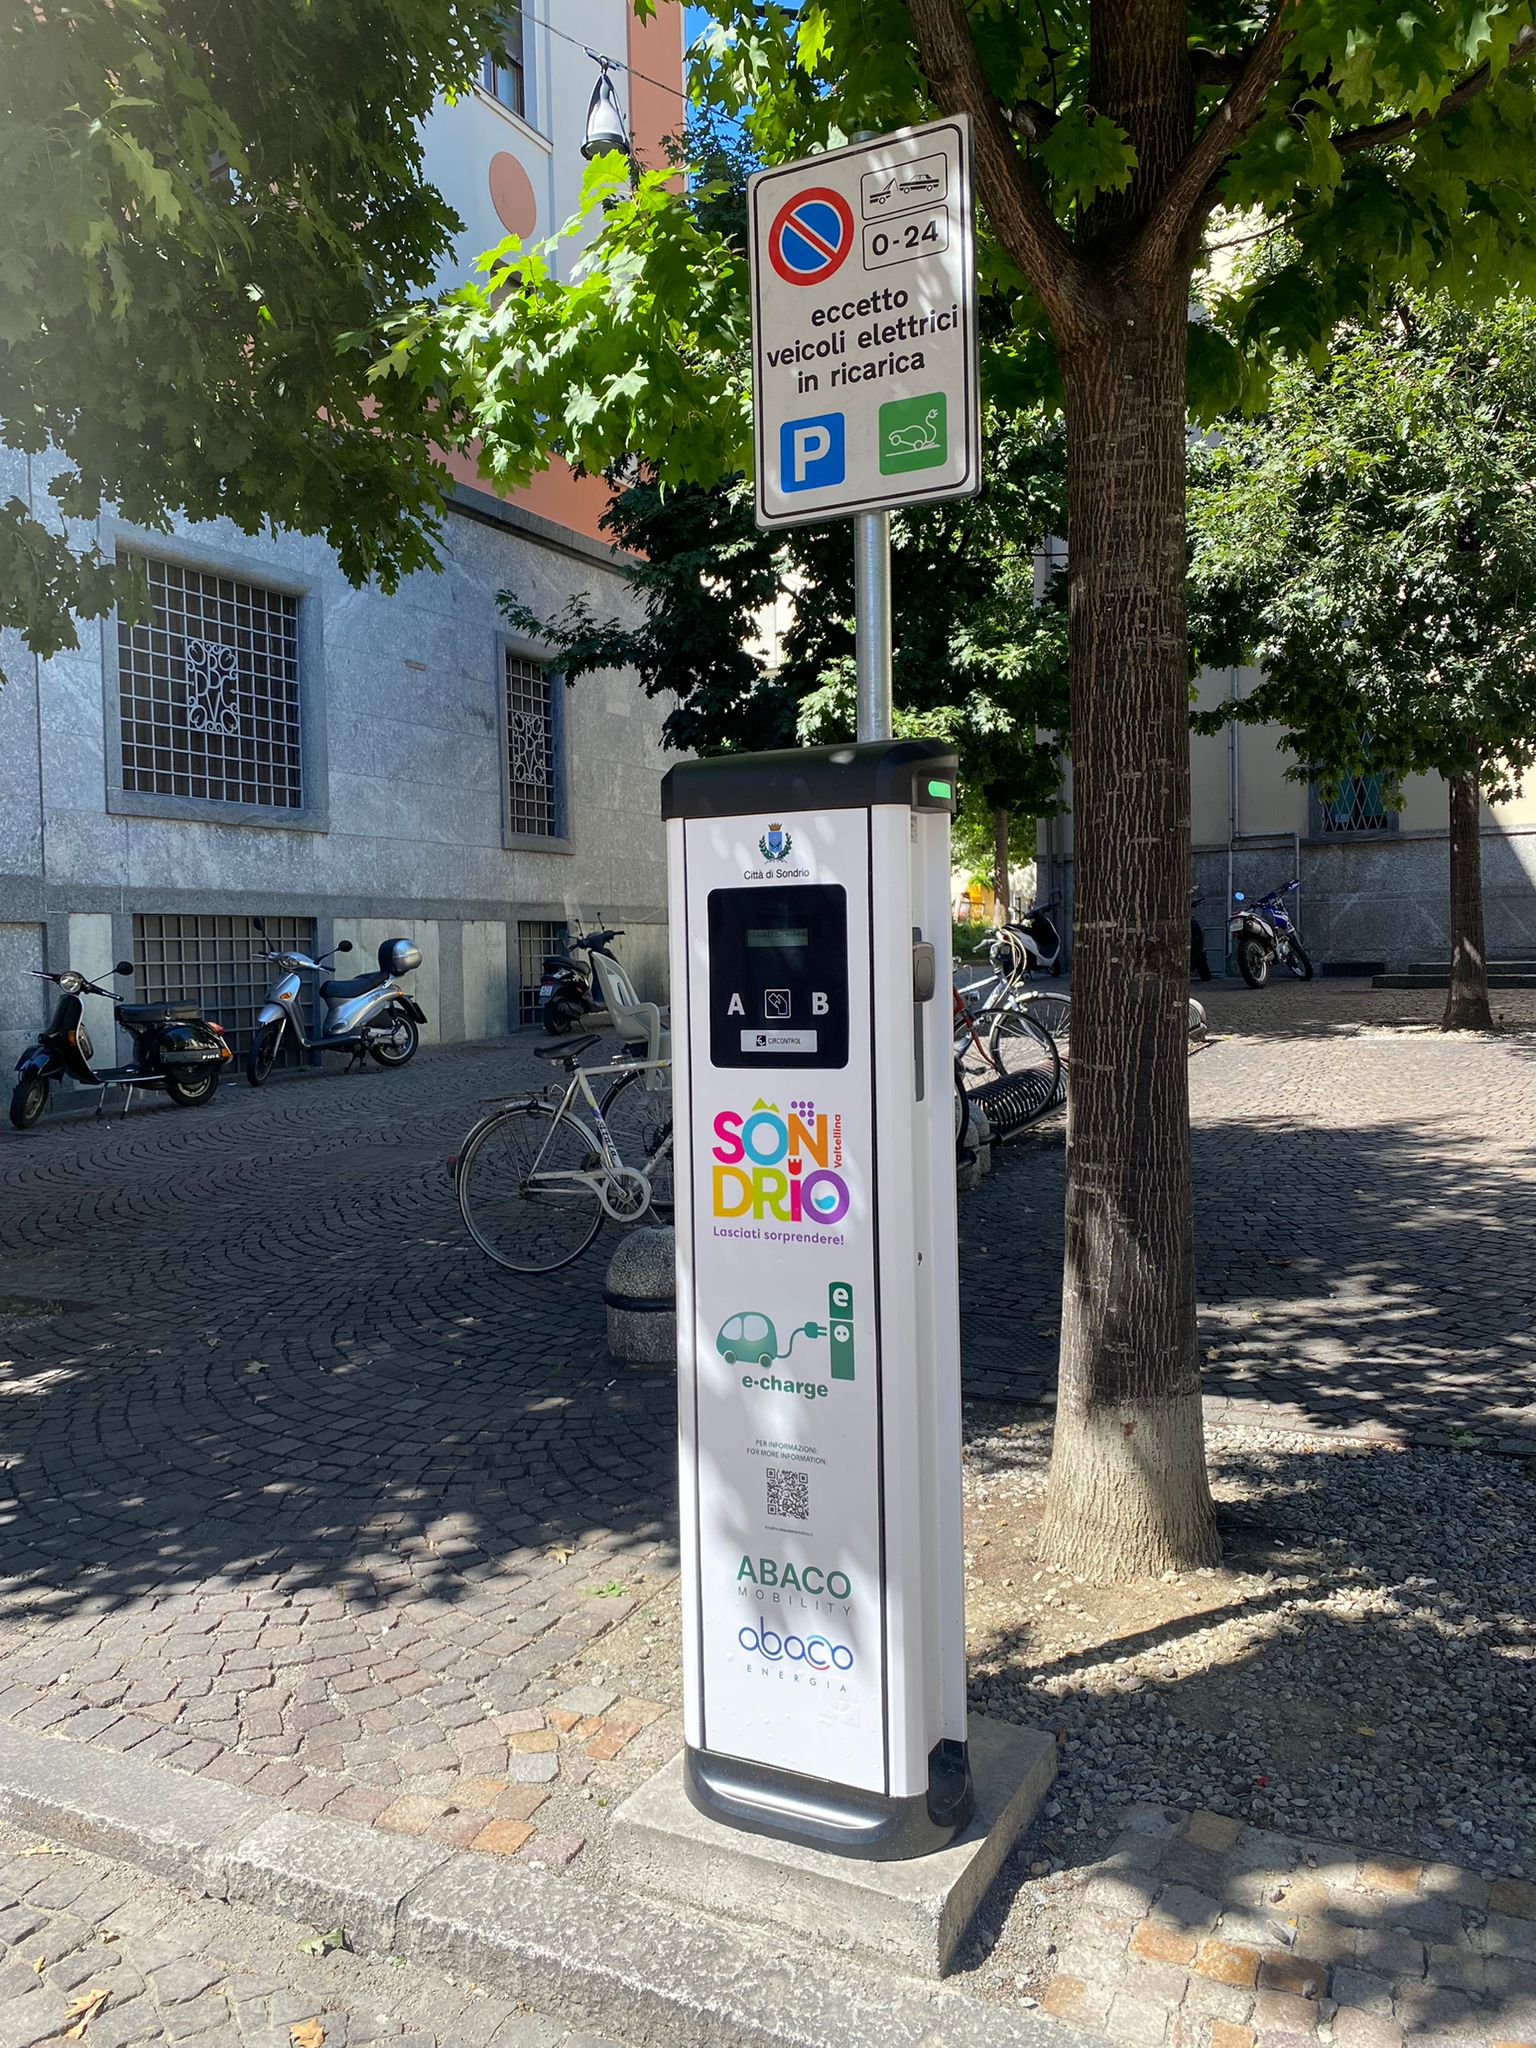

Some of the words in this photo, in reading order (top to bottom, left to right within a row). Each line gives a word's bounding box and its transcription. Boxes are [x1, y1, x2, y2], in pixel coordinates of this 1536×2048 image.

[811, 287, 908, 326] eccetto
[766, 331, 845, 368] veicoli
[857, 304, 959, 349] elettrici
[797, 370, 819, 394] in
[830, 350, 925, 387] ricarica
[794, 424, 831, 482] P
[743, 869, 764, 880] Città
[765, 868, 774, 879] di
[776, 868, 810, 878] Sondrio
[727, 992, 745, 1015] A
[811, 991, 830, 1015] B
[767, 1037, 801, 1045] CIRCONTROL
[833, 1113, 842, 1169] Valtellina
[713, 1226, 760, 1239] Lasciati
[764, 1231, 844, 1245] sorprendere!
[832, 1287, 850, 1308] e
[741, 1375, 829, 1400] e-charge
[746, 1448, 760, 1456] FOR
[761, 1449, 779, 1459] MORE
[755, 1439, 767, 1447] PER
[737, 1555, 852, 1600] ABACO
[738, 1586, 851, 1616] MOBILITY
[738, 1616, 854, 1671] abaco
[747, 1664, 847, 1693] ENERGIA
